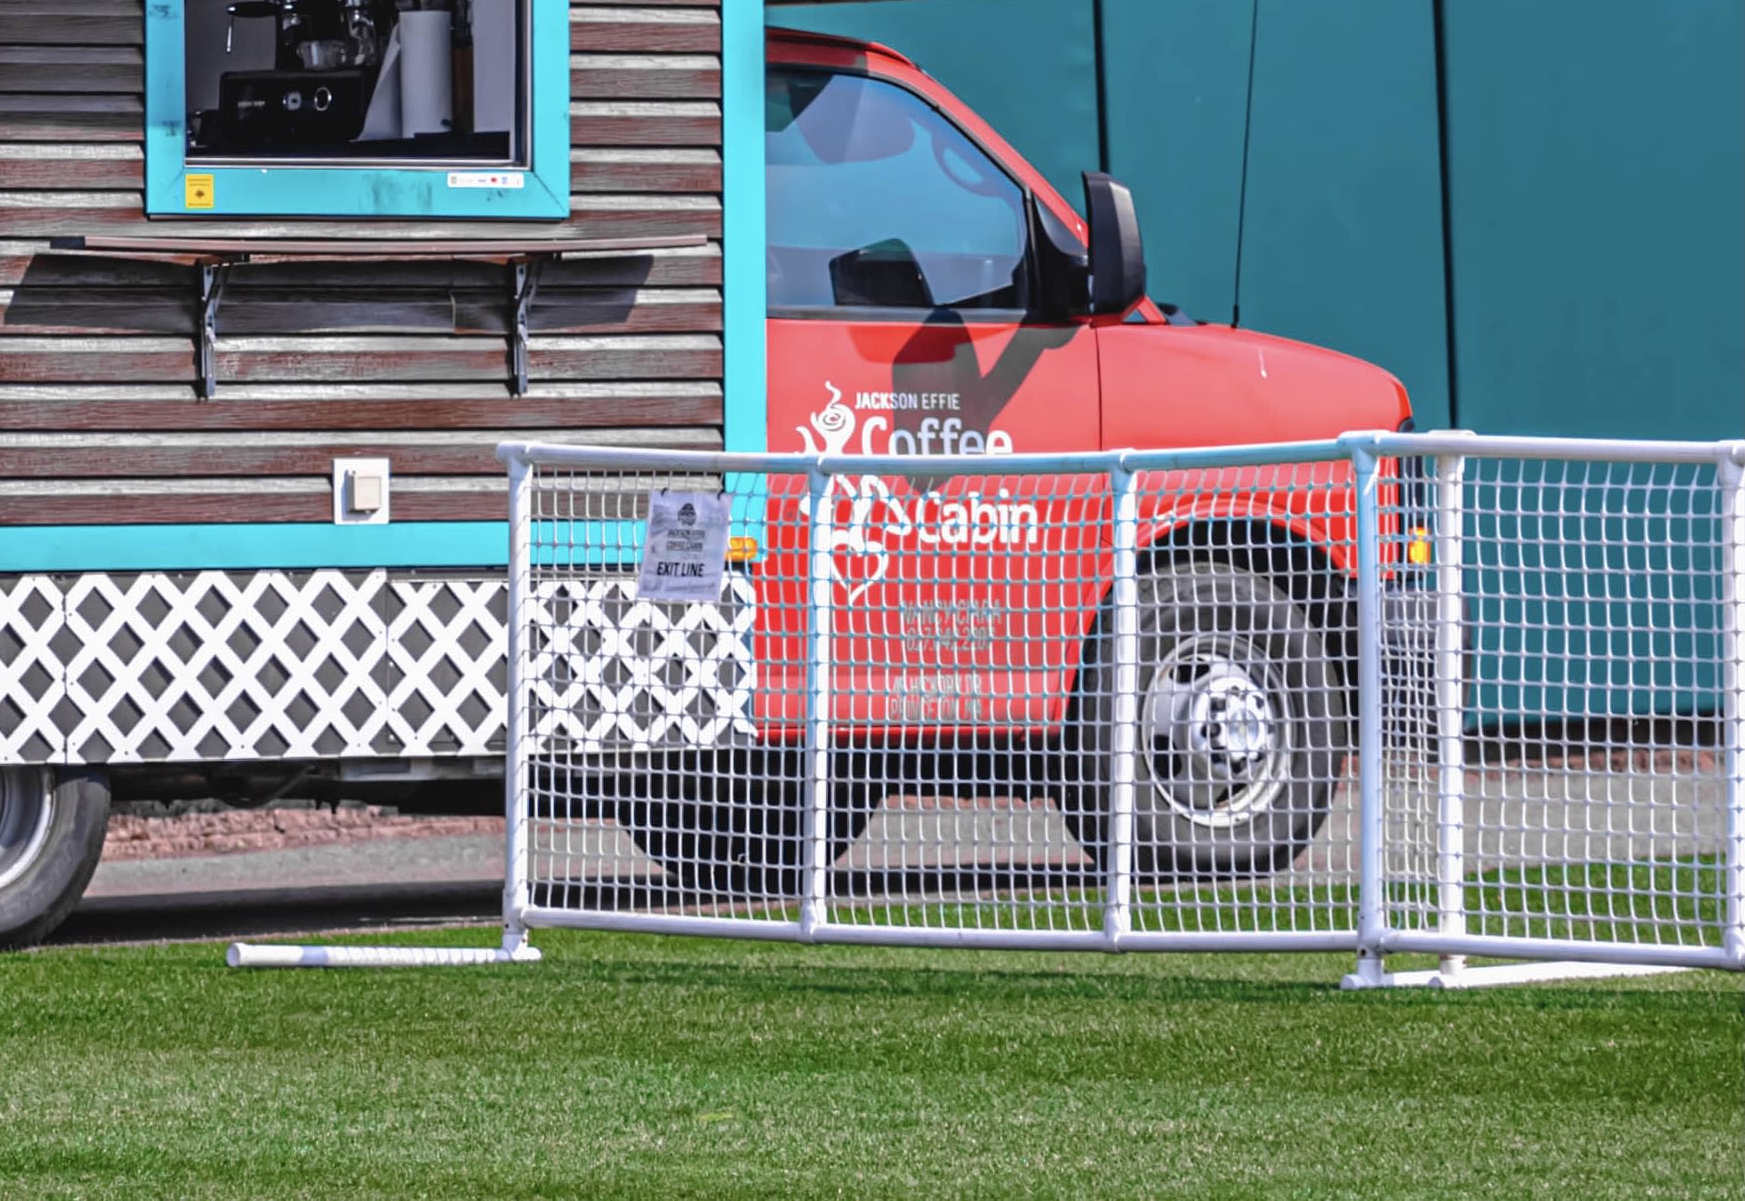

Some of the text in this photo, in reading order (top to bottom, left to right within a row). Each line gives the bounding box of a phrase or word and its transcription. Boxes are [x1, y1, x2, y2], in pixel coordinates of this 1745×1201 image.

[854, 391, 961, 411] JACKSON EFFIE
[861, 415, 1014, 456] Coffee
[916, 488, 1039, 545] Cabin
[657, 561, 705, 577] EXIT LINE
